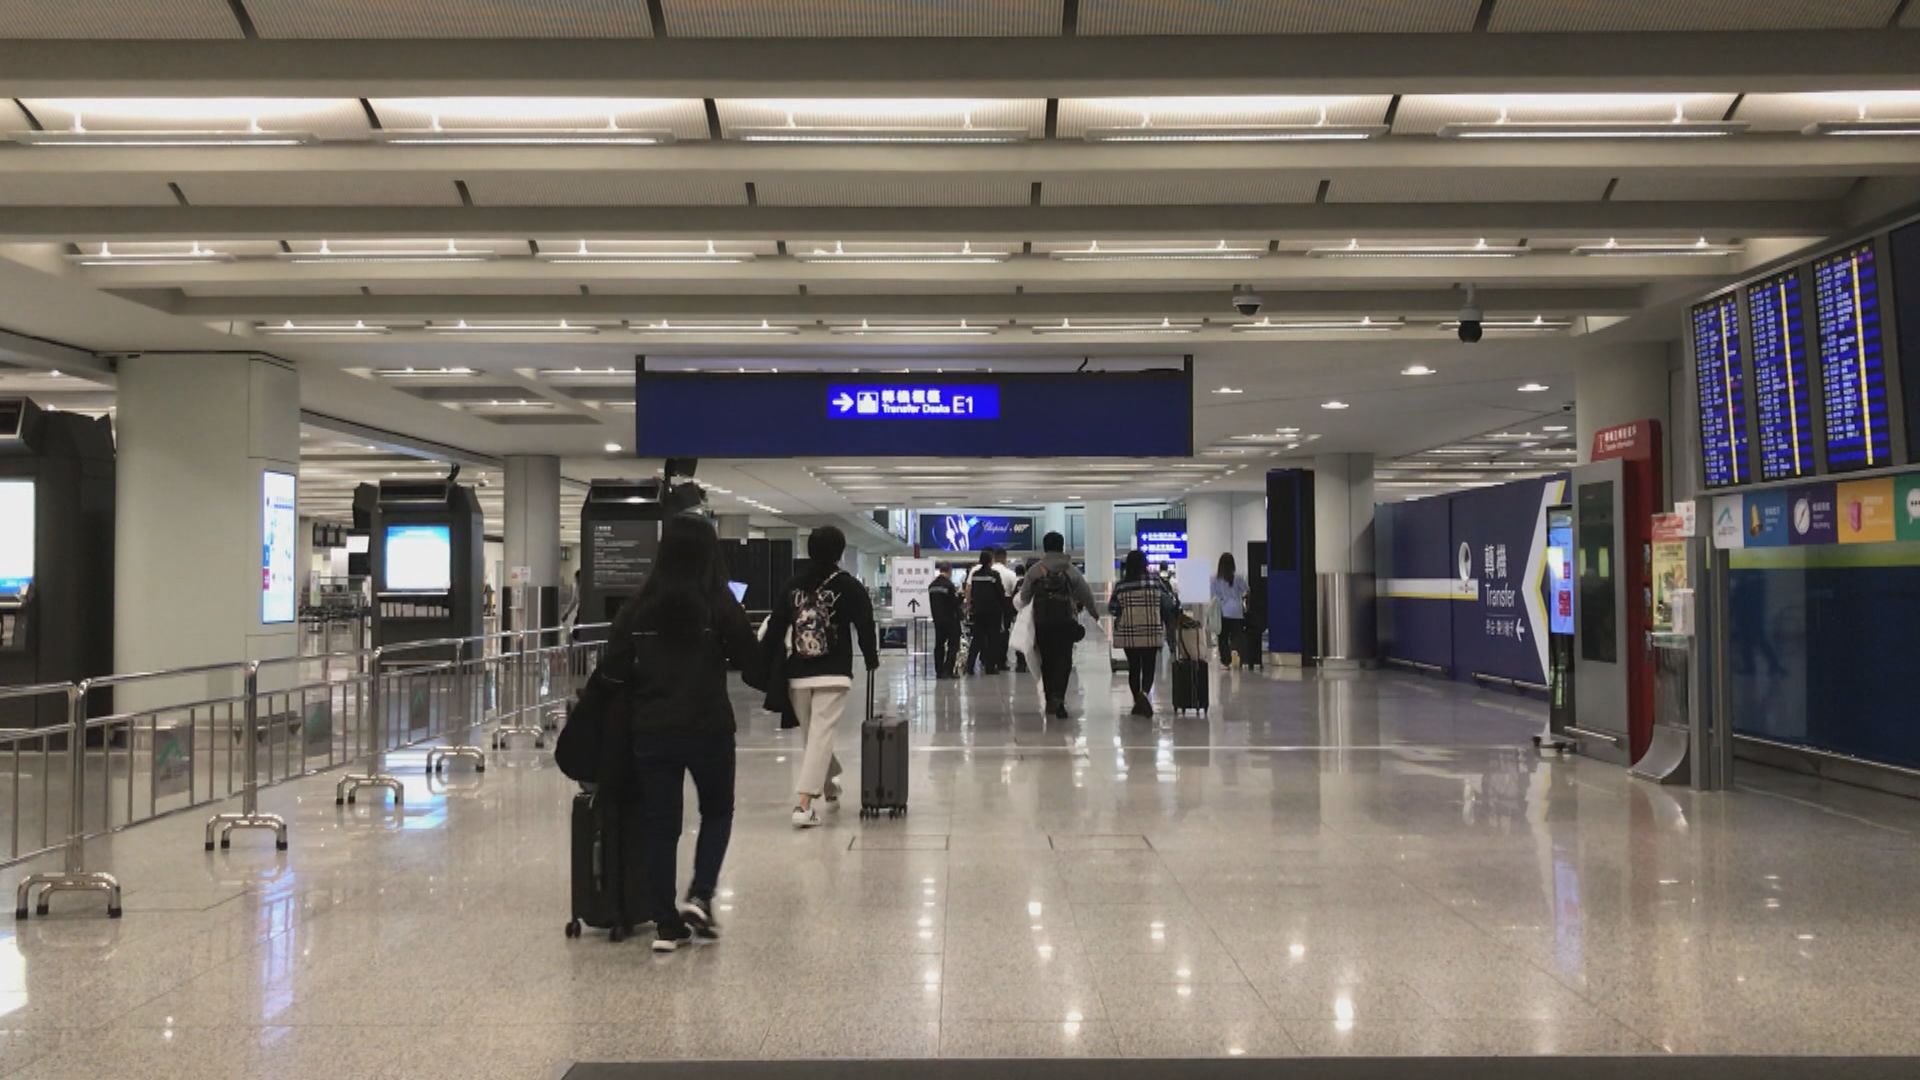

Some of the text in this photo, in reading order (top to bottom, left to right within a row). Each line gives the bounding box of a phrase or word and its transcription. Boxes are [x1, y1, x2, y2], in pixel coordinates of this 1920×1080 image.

[882, 403, 951, 414] Transfer Desks
[952, 395, 974, 414] E1
[902, 578, 925, 586] Arrival
[1485, 582, 1516, 608] Transfer
